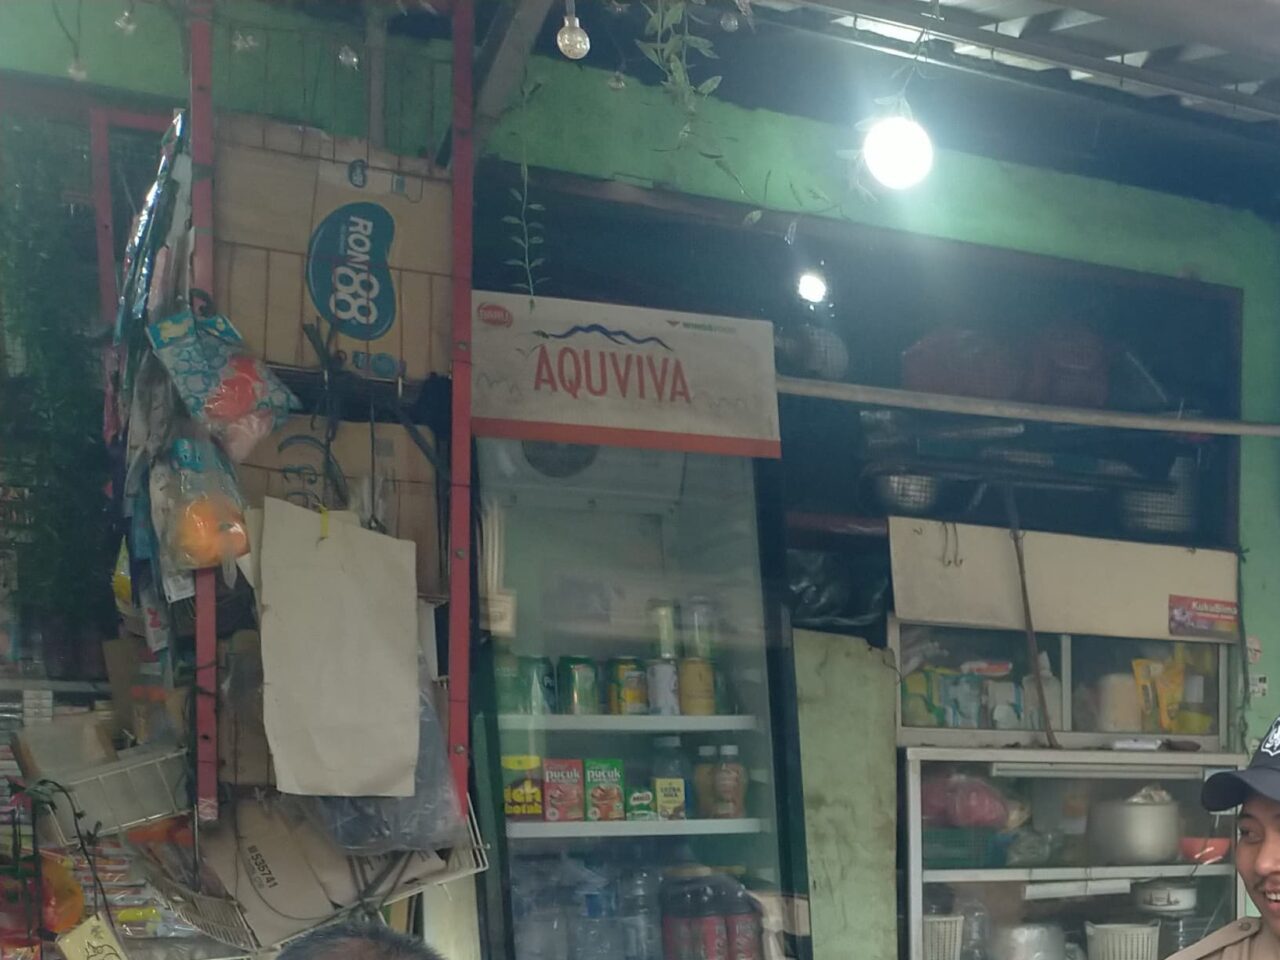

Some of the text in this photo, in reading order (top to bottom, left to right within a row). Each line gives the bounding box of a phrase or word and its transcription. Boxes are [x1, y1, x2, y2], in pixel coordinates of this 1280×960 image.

[533, 344, 691, 404] AQUVIVA
[545, 768, 581, 782] pucuk
[587, 767, 622, 782] pucuk
